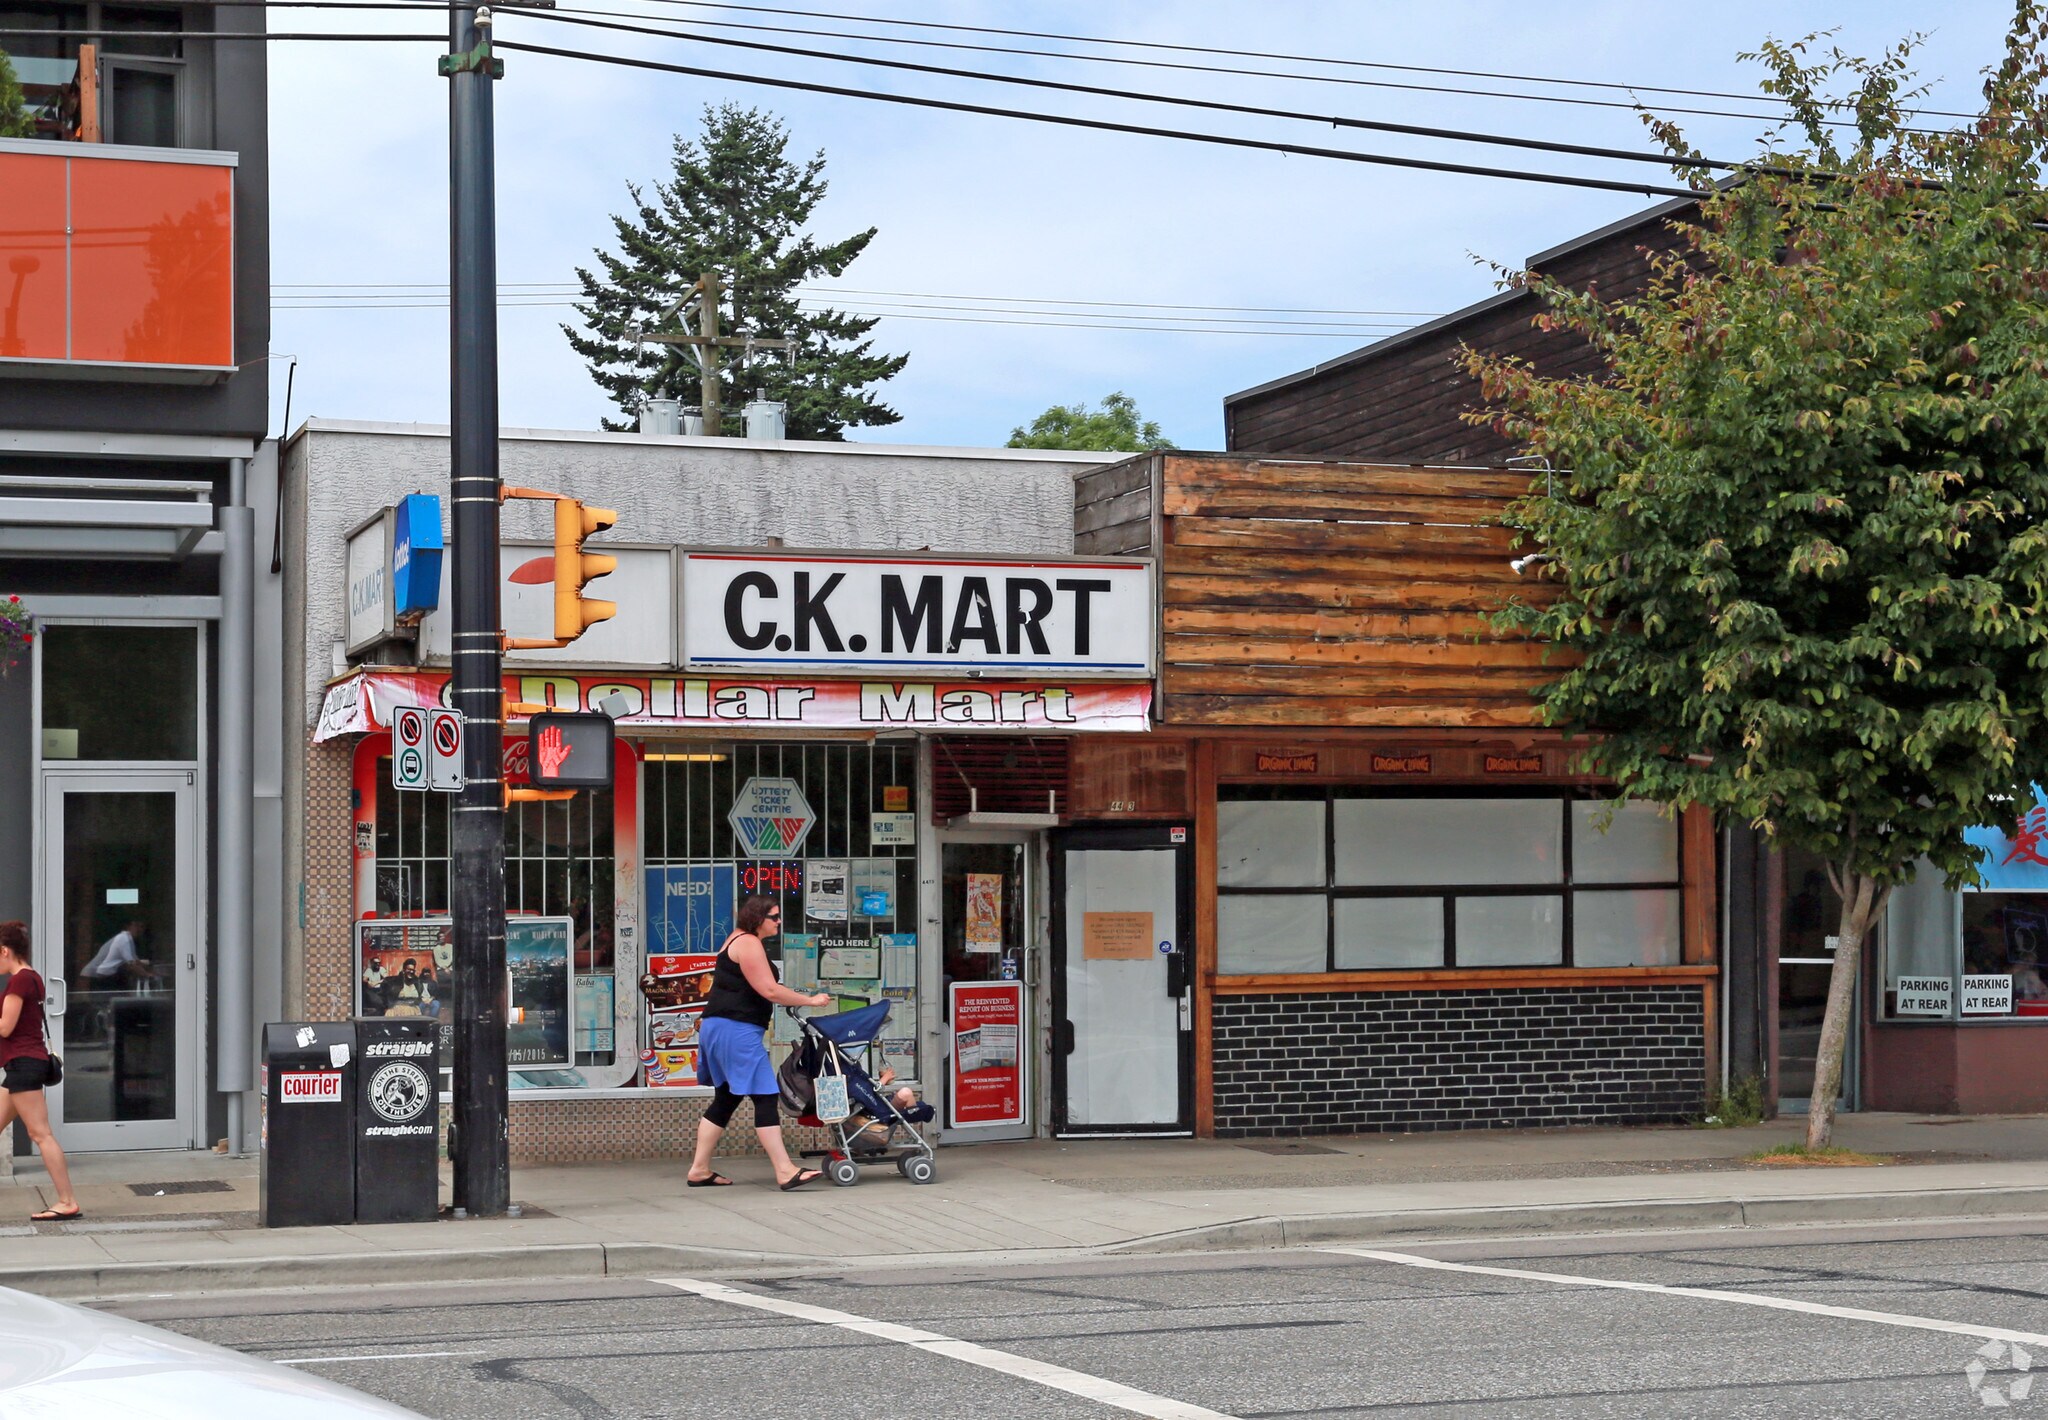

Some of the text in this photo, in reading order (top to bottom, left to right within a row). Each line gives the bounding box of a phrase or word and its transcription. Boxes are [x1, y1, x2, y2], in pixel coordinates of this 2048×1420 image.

[520, 676, 1078, 723] Dollar Mart
[751, 787, 792, 796] LOTTERY
[743, 867, 799, 890] OPEN
[820, 939, 870, 947] SOLD HERE
[575, 977, 595, 986] Baba
[1900, 980, 1949, 992] PARKING
[1964, 979, 2010, 990] PARKING
[882, 989, 903, 997] Gold
[1901, 999, 1948, 1010] AT REAR
[1965, 997, 2009, 1009] AT REAR
[365, 1041, 434, 1057] straight
[375, 1067, 424, 1088] ON THE STREET
[284, 1074, 340, 1096] courier
[377, 1098, 422, 1116] ON THE WEB
